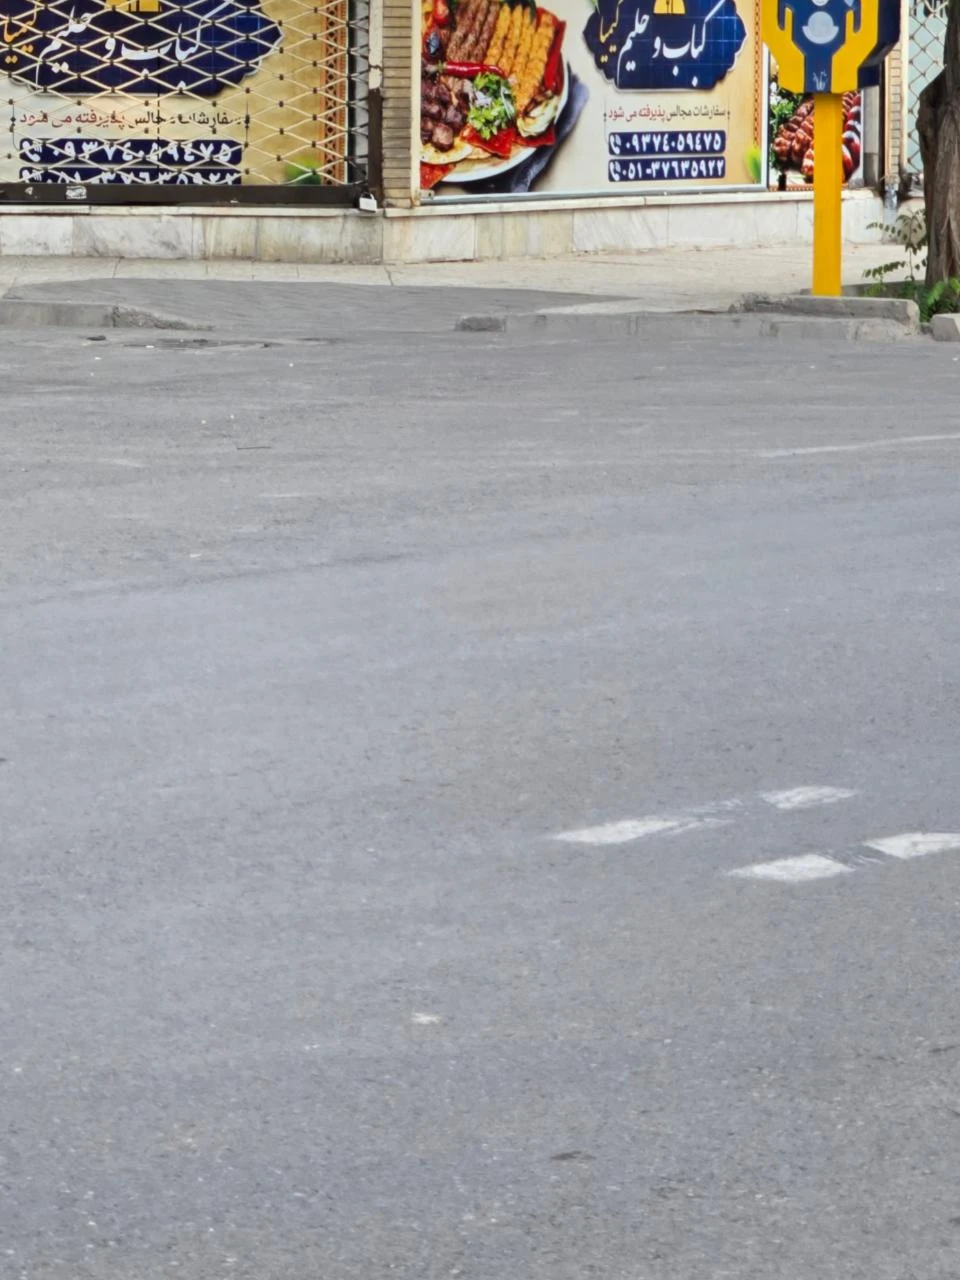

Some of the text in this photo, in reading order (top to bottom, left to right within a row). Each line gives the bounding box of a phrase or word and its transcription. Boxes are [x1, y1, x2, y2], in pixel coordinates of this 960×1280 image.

[35, 5, 95, 91] حلیم
[102, 35, 117, 61] و
[617, 8, 650, 87] حلیم
[651, 35, 662, 59] و
[608, 104, 726, 124] سفارشات مجالس پذیرفته می شود
